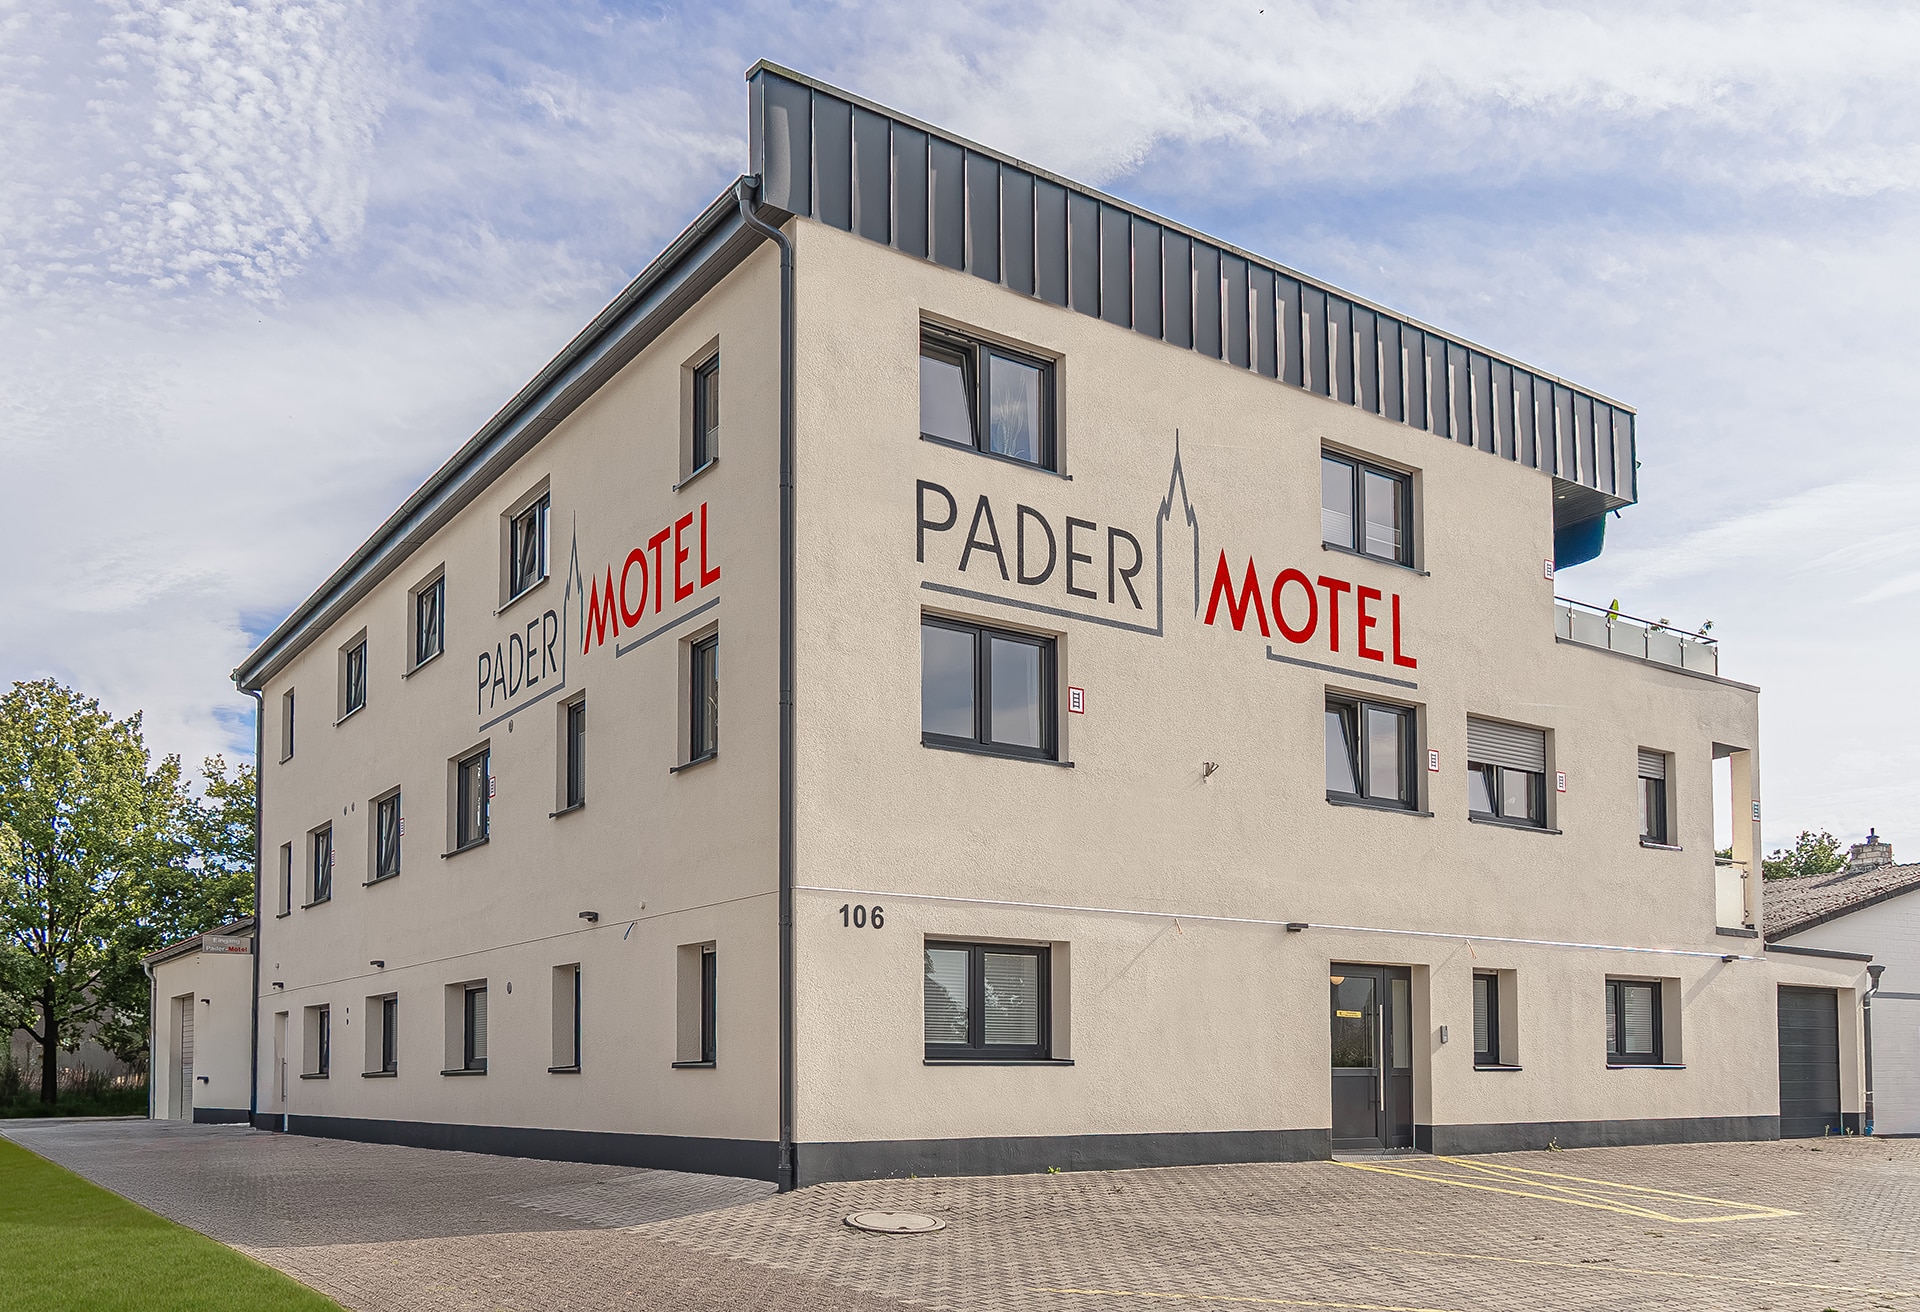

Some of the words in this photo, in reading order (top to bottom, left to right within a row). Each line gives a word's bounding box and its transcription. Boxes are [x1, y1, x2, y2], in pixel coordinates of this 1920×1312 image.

[478, 609, 558, 715] PADER
[583, 501, 721, 655] MOTEL
[915, 478, 1143, 610] PADER
[1204, 548, 1418, 669] MOTEL
[213, 937, 240, 945] Eingang
[839, 903, 884, 929] 106
